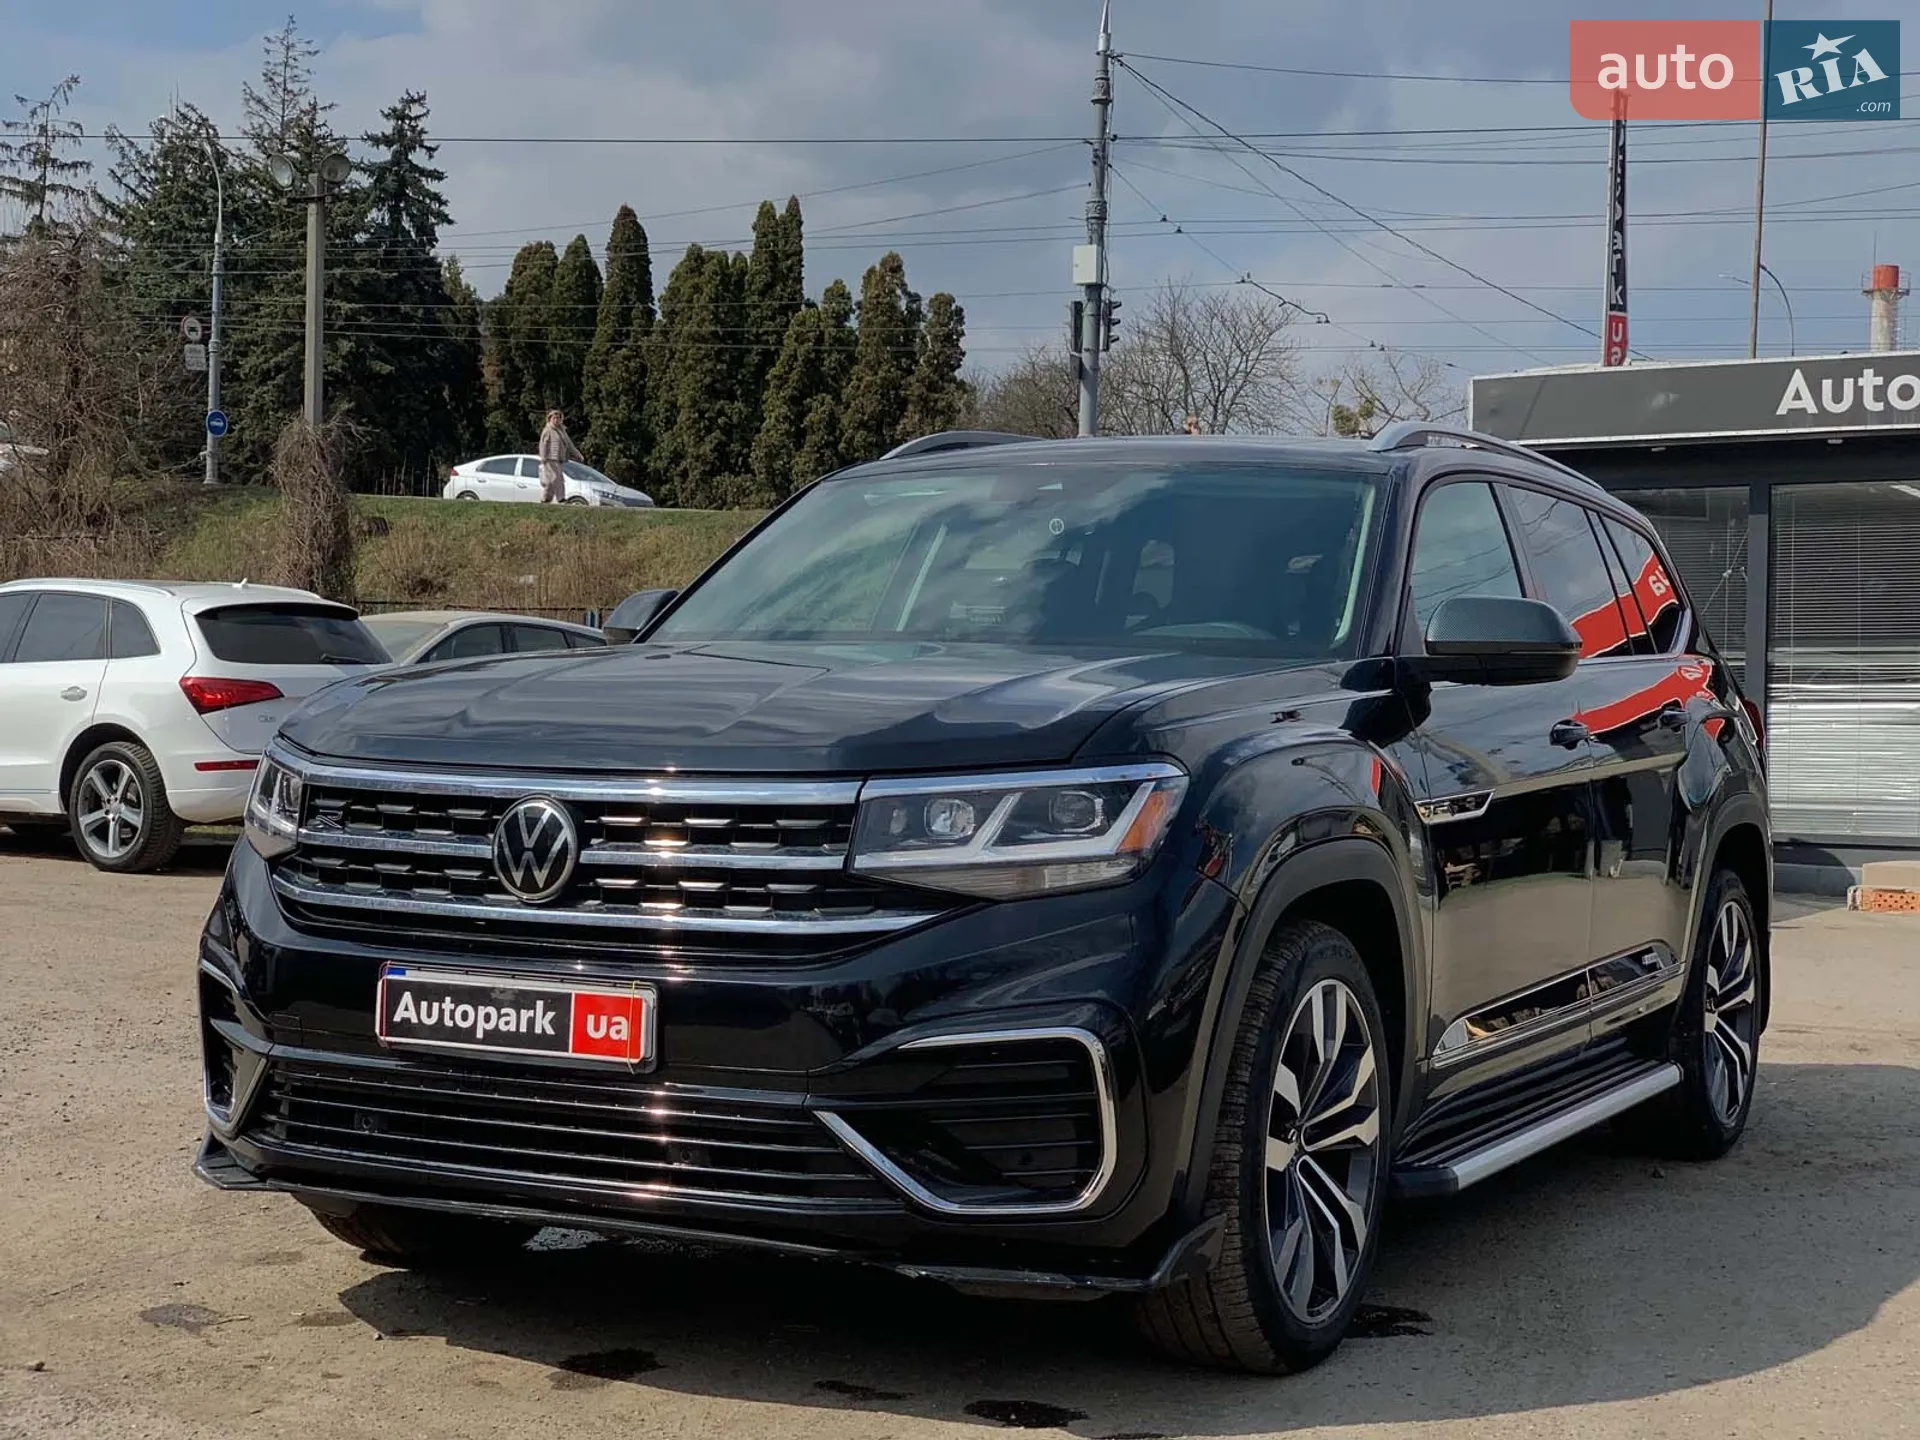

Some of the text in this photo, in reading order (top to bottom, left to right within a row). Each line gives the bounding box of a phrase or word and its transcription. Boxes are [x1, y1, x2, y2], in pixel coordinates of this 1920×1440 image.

[1776, 368, 1920, 415] Auto
[393, 991, 629, 1041] Autopark ua
